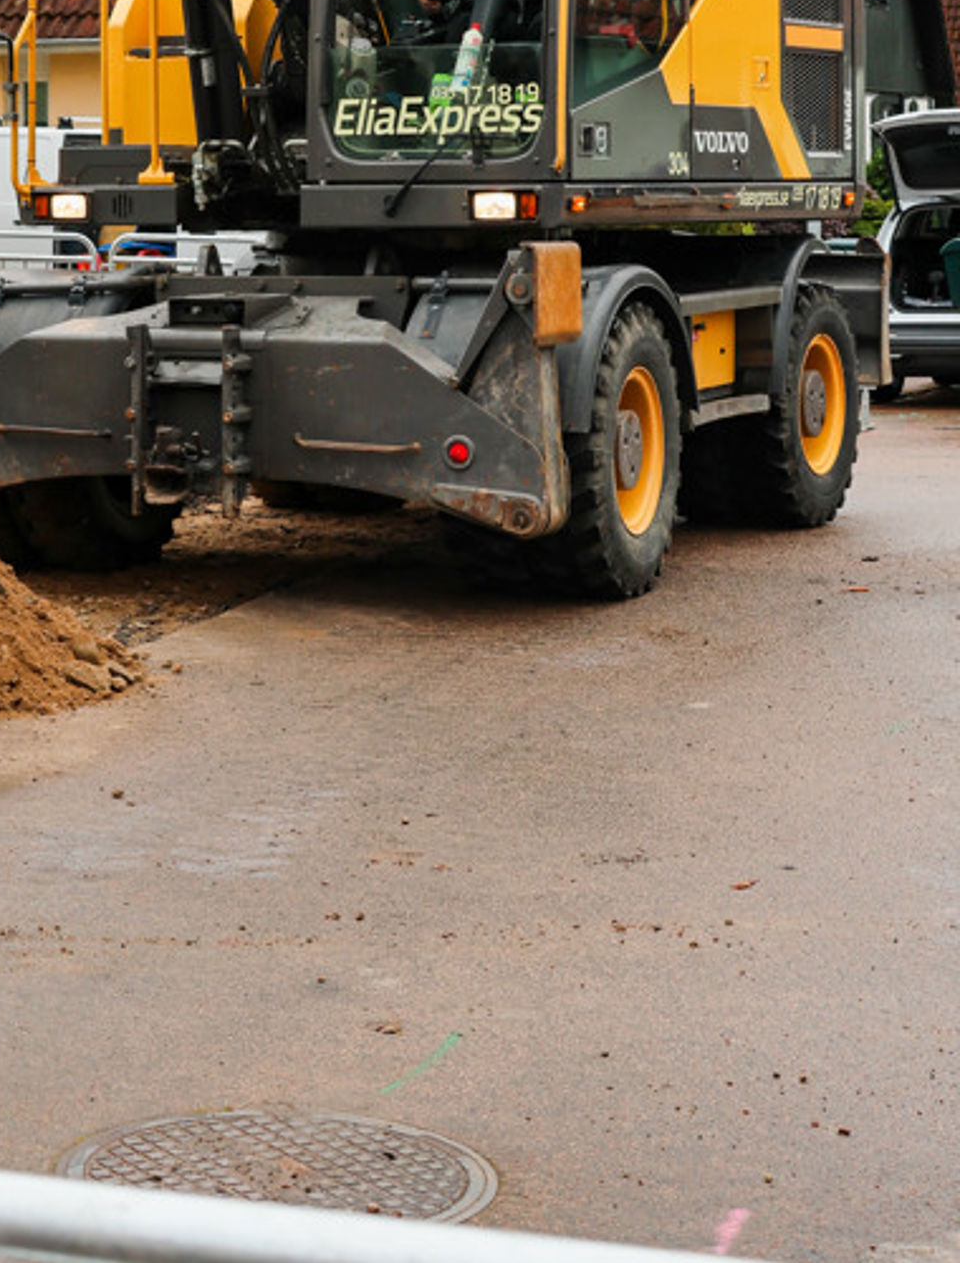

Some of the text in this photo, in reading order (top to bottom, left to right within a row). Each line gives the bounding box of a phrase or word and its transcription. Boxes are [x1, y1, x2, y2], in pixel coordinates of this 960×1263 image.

[462, 86, 482, 105] 17
[487, 84, 512, 105] 18
[516, 81, 540, 103] 19
[333, 95, 544, 145] EliaExpress
[694, 131, 749, 153] VOLVO
